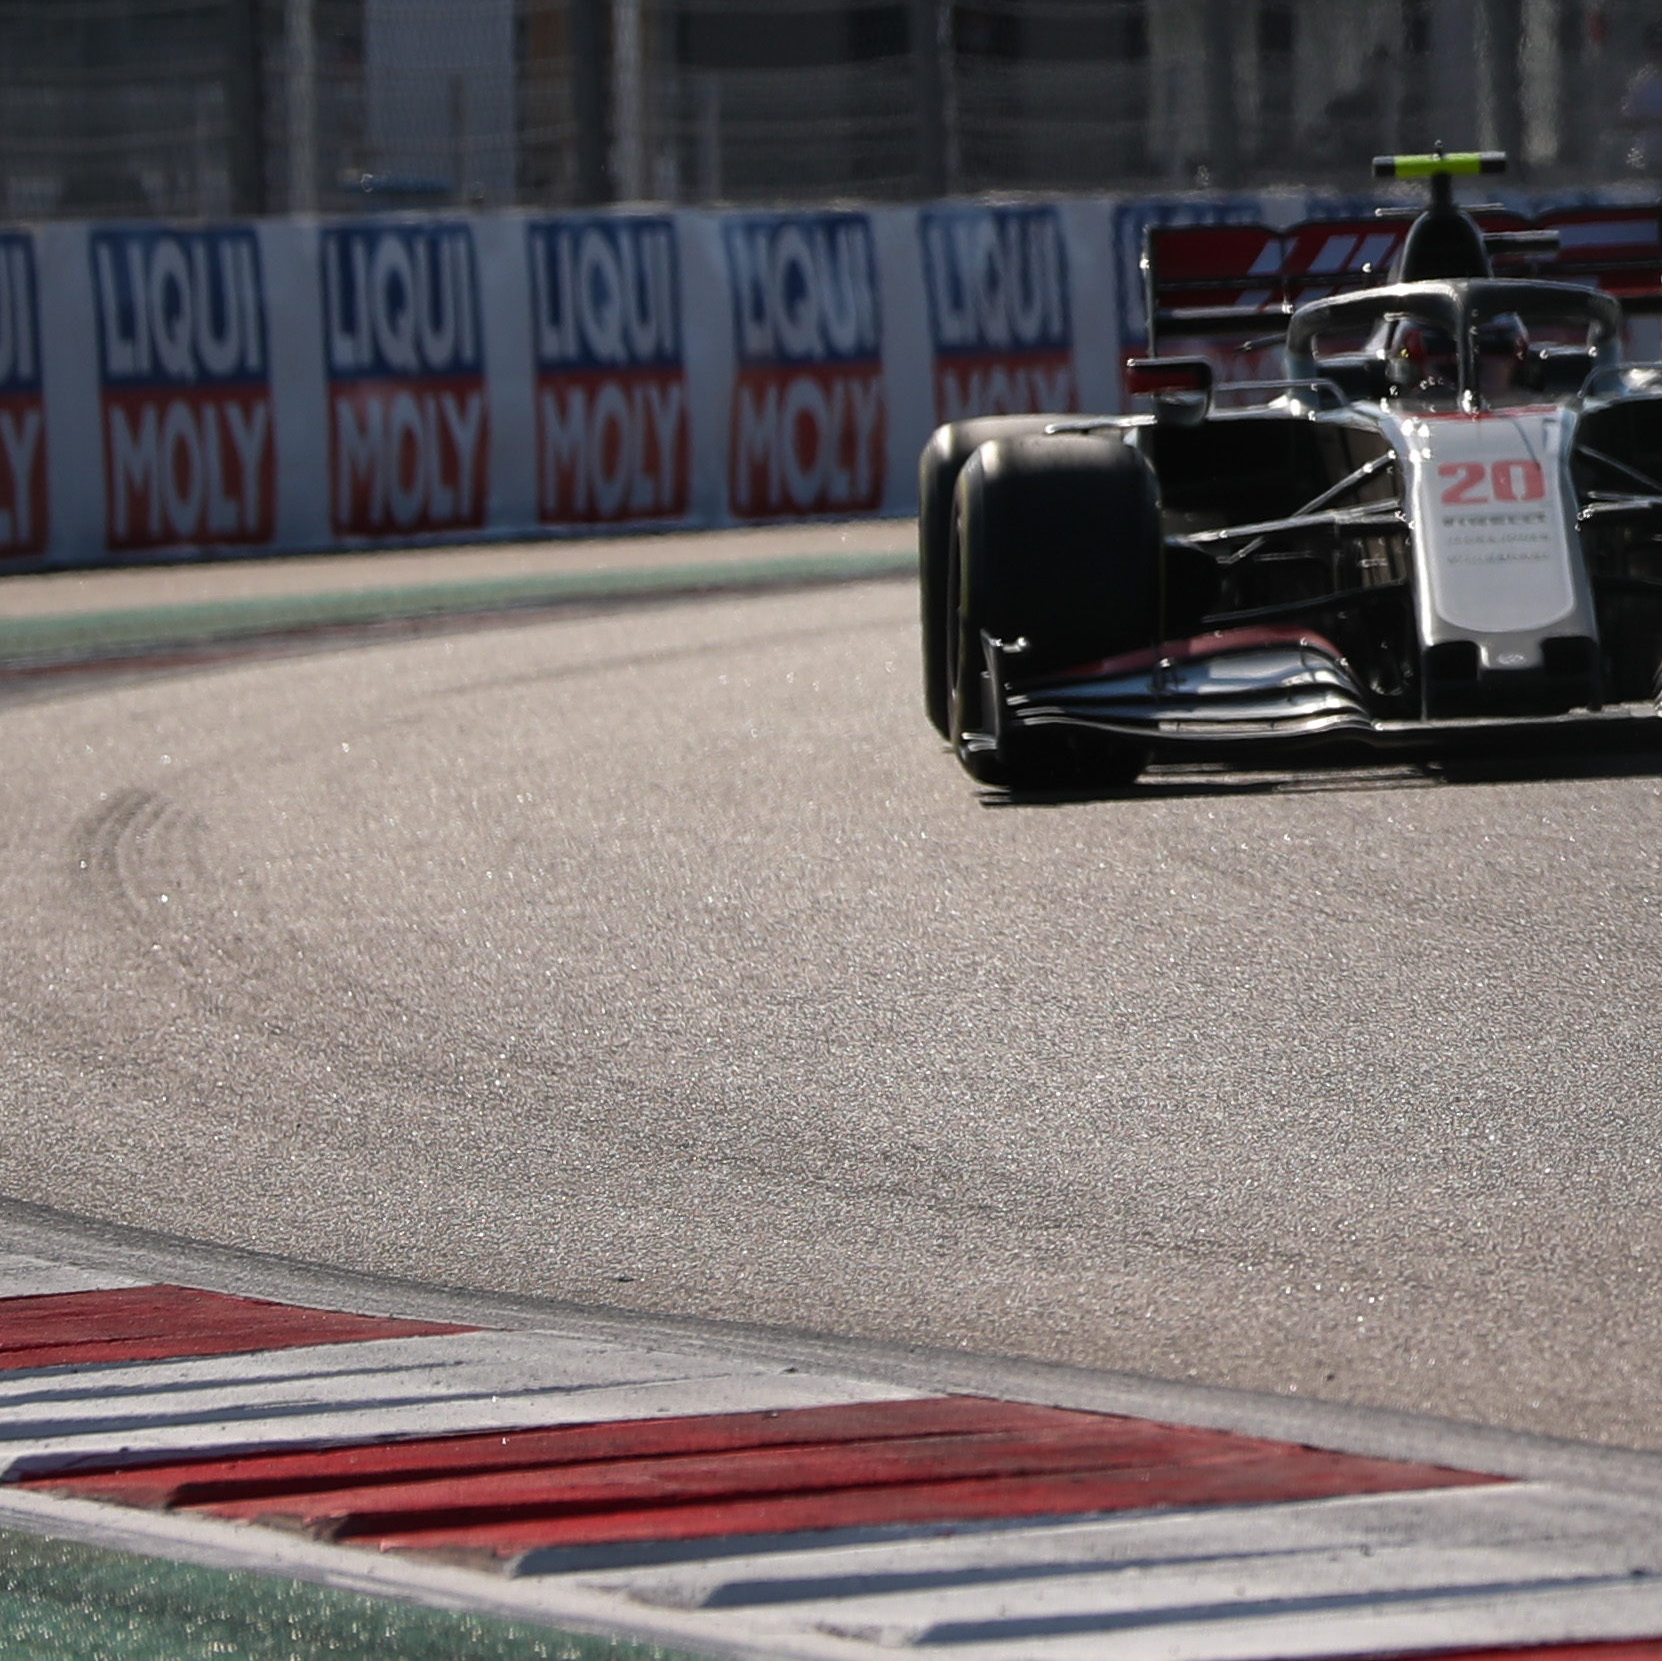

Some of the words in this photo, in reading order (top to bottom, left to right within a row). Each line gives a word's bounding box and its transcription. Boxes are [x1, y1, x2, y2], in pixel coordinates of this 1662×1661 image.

[99, 236, 263, 384] LIQUI
[327, 230, 477, 375] LIQUI
[532, 221, 680, 363] LIQUI
[731, 216, 877, 358] LIQUI
[109, 400, 271, 536] MOLY
[337, 390, 486, 526] MOLY
[541, 380, 685, 514] MOLY
[736, 376, 884, 513] MOLY
[1437, 458, 1547, 506] 20
